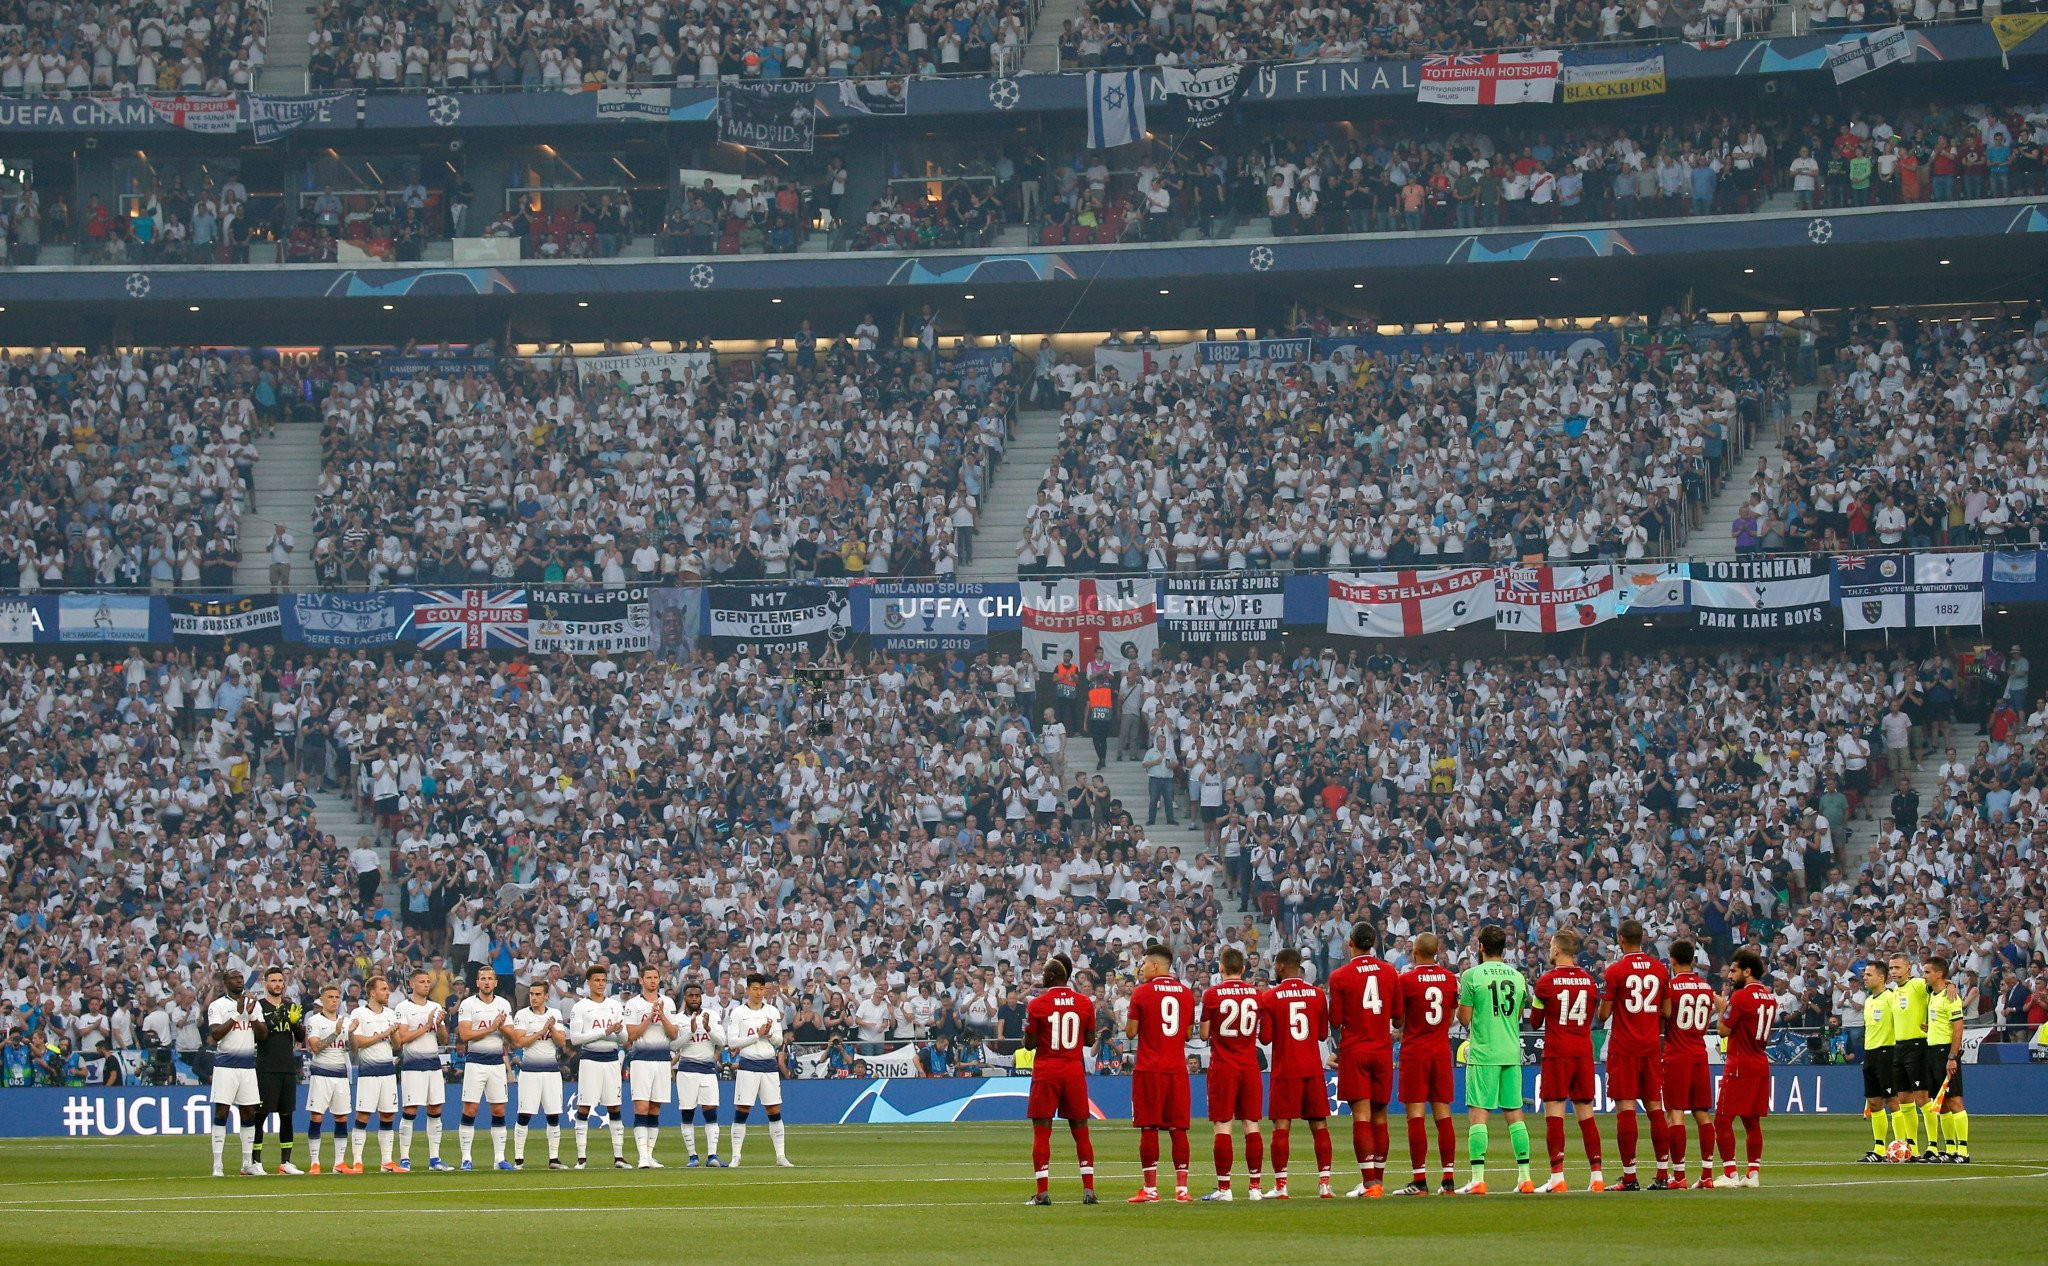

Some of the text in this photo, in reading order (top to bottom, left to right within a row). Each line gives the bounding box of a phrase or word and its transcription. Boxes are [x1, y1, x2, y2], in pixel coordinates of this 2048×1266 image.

[1832, 33, 1903, 67] STEVENAGE SPURS
[1425, 65, 1552, 78] TOTTENHAM HOTSPUR
[1296, 66, 1418, 93] FINAL
[1421, 85, 1476, 93] HERTFORDSHIRE
[1566, 78, 1663, 99] BLACKBURN
[0, 105, 65, 125] UEFA
[1208, 345, 1240, 361] 1882
[1267, 343, 1303, 360] COYS
[584, 354, 678, 370] NORTH STAFFS
[1706, 558, 1811, 579] TOTTENHAM
[874, 583, 983, 595] MIDLAND SPURS
[1041, 580, 1134, 600] T H
[1168, 577, 1279, 591] NORTH EAST SPURS
[1340, 571, 1482, 601] THE STELLA BAR
[1880, 586, 1899, 594] CAN'T
[1901, 585, 1921, 593] SMILE
[1922, 584, 1953, 592] WITHOUT
[1954, 583, 1969, 591] YOU
[750, 592, 787, 607] N17
[1496, 583, 1601, 604] TOTTENHAM
[297, 593, 386, 612] ELY SPURS
[898, 597, 971, 618] UEFA
[1934, 604, 1960, 615] 1882
[172, 610, 280, 631] WEST SUSSEX SPURS
[426, 608, 523, 622] COV SPURS
[714, 606, 827, 624] GENTLEMEN'S
[1034, 612, 1143, 627] POTTERS BAR
[1496, 609, 1521, 624] N17
[1699, 607, 1822, 628] PARK LANE BOYS
[565, 622, 623, 635] SPURS
[750, 623, 793, 636] CLUB
[1169, 618, 1278, 631] IT'S BEEN MY LIFE AND
[106, 631, 121, 639] YOU
[121, 631, 146, 640] KNOW
[333, 631, 396, 645] EST FACERE
[1181, 631, 1267, 643] I LOVE THIS CLUB
[887, 638, 971, 650] MADRID 2019
[1041, 642, 1058, 660] F
[1356, 963, 1381, 973] VIRGIL
[1632, 961, 1651, 970] MATIP
[1418, 973, 1447, 983] FABINHO
[1553, 977, 1591, 986] HENDERSON
[1154, 984, 1183, 993] FIRMINO
[1217, 987, 1257, 996] ROBERTSON
[1276, 988, 1316, 1000] WIJNALDUM
[1362, 975, 1383, 1015] 4
[1625, 974, 1660, 1014] 32
[1054, 996, 1075, 1006] MANÉ
[1487, 979, 1517, 1017] 13
[1424, 986, 1443, 1026] 3
[1557, 989, 1588, 1026] 14
[1676, 993, 1710, 1031] 66
[1160, 995, 1180, 1037] 9
[1219, 998, 1258, 1038] 26
[1289, 1001, 1309, 1041] 5
[1756, 1003, 1775, 1041] 11
[232, 1021, 253, 1031] AIA
[478, 1019, 493, 1030] AI
[592, 1018, 613, 1030] AIA
[1048, 1011, 1080, 1051] 10
[690, 1032, 710, 1043] AIA
[866, 1062, 908, 1078] BRING
